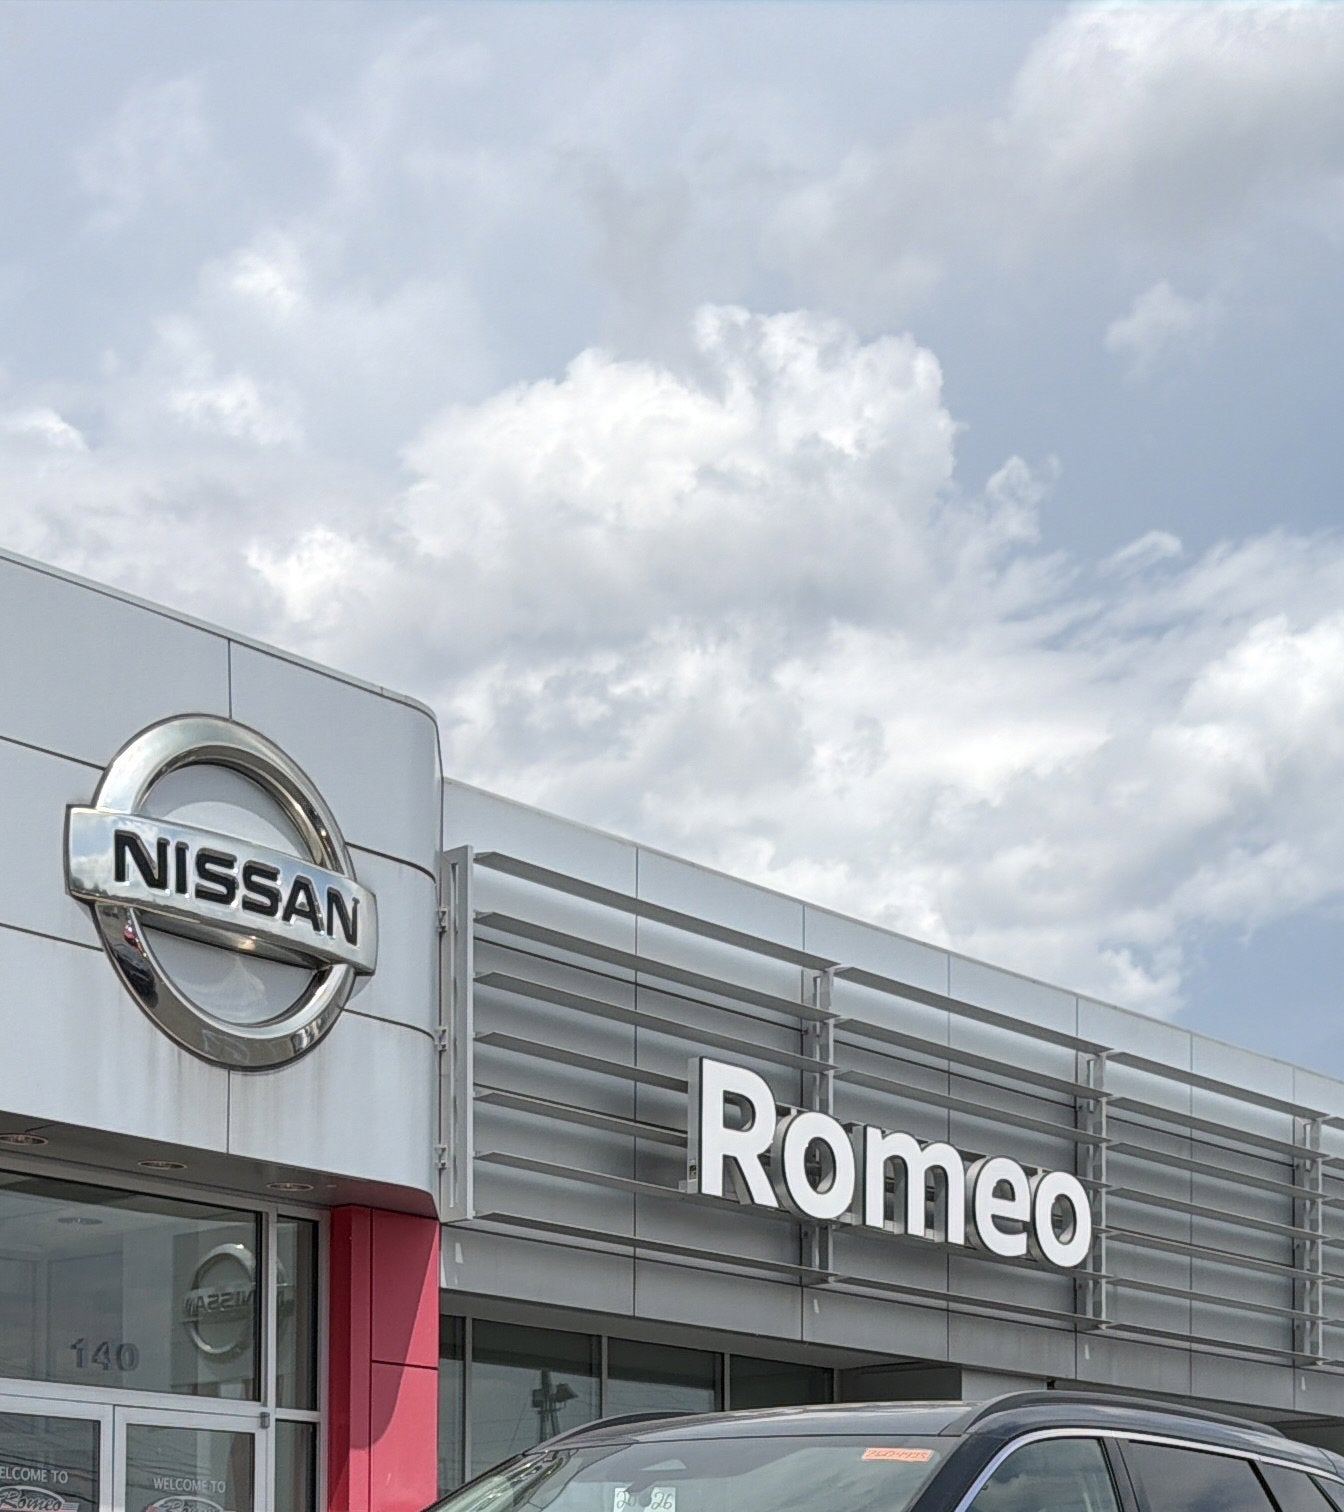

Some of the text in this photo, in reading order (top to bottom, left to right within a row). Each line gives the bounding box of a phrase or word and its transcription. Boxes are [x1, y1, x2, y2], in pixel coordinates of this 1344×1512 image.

[113, 829, 360, 947] NISSAN
[690, 1056, 1092, 1268] Romeo
[71, 1338, 140, 1372] 140
[50, 1470, 69, 1484] TO
[153, 1477, 226, 1493] WELCOME TO
